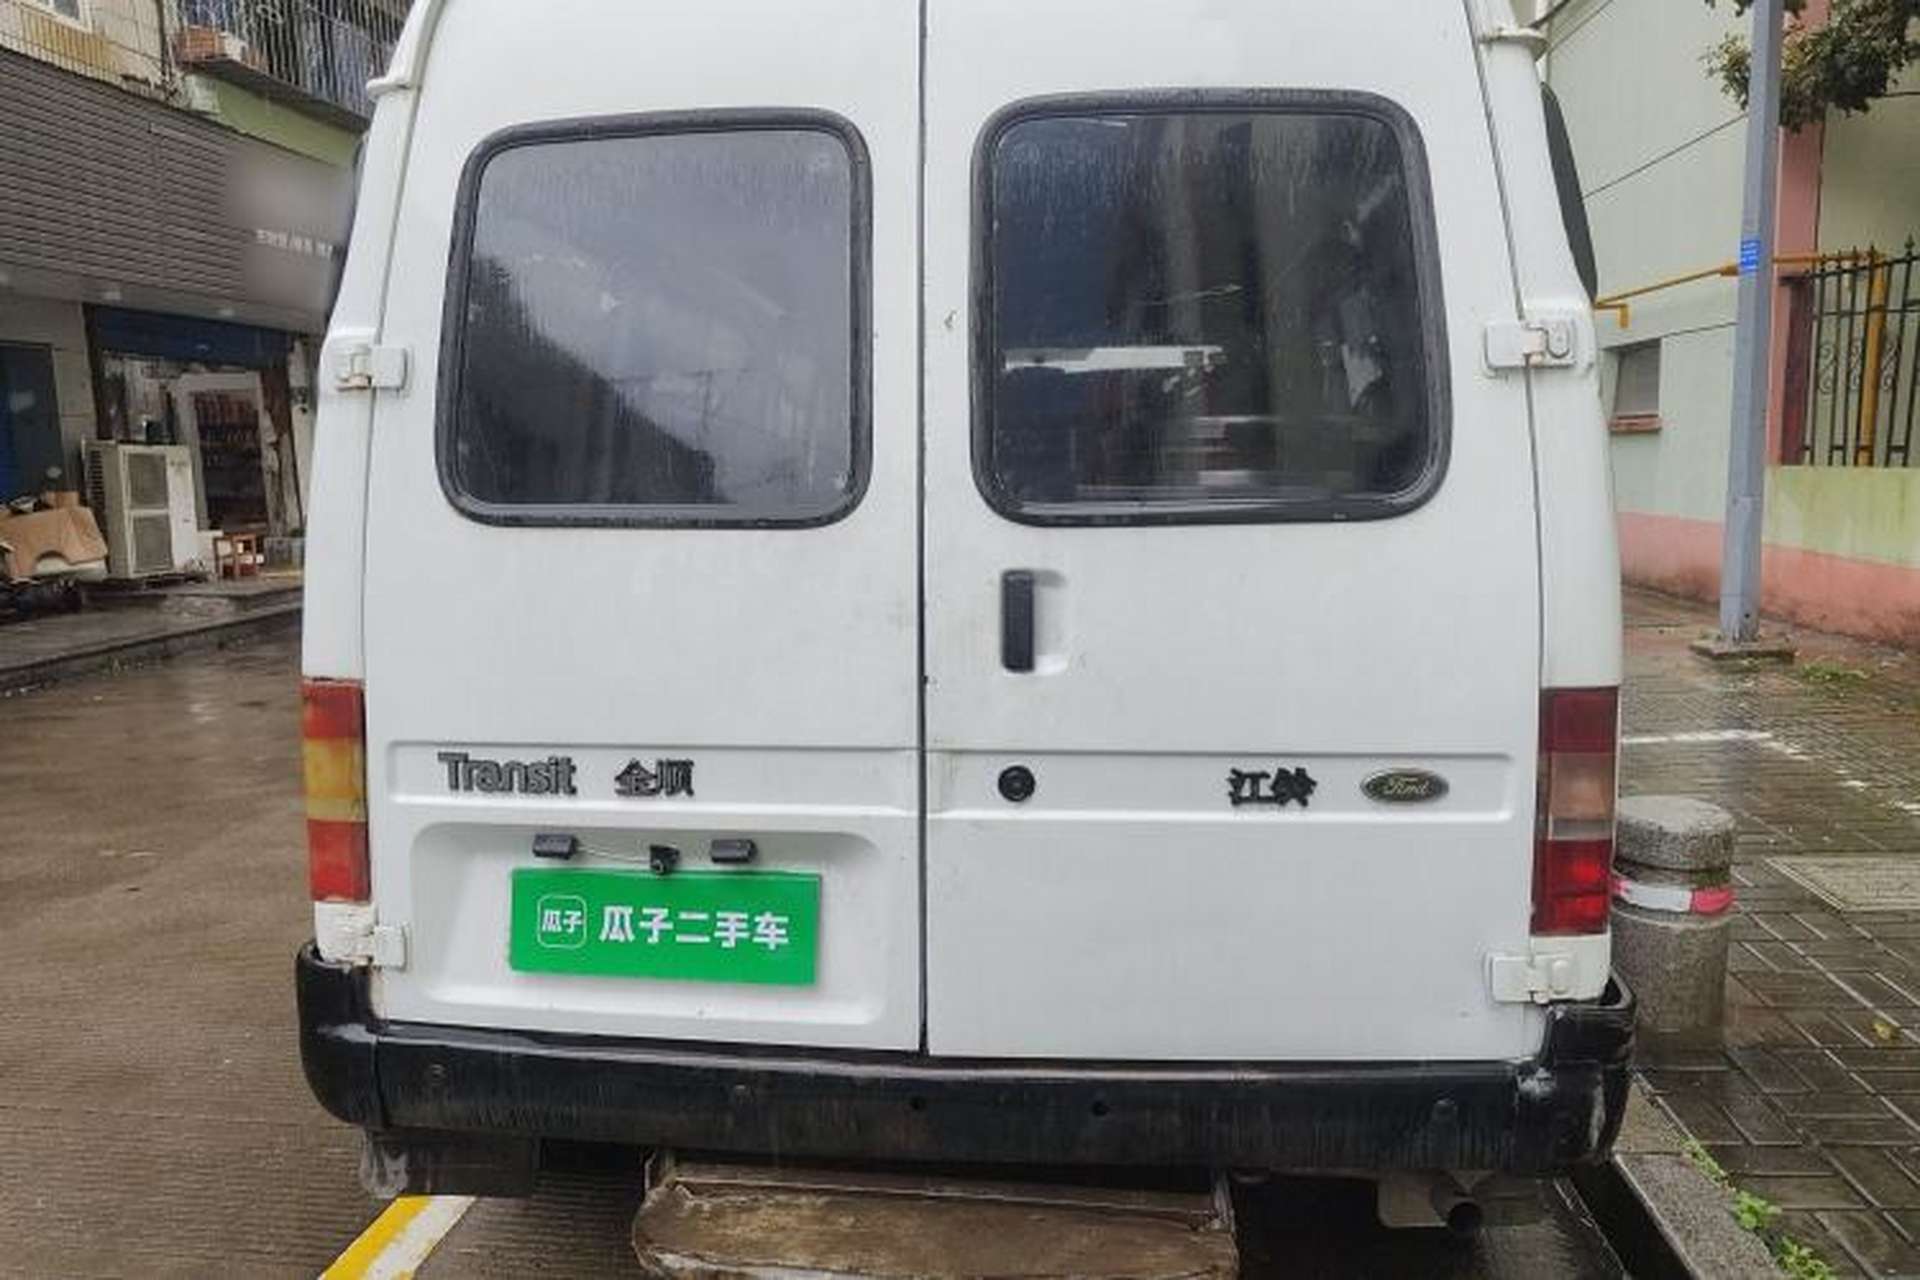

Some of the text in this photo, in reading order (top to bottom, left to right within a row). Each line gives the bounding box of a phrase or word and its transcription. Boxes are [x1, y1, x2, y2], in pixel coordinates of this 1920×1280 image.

[437, 752, 577, 796] Transit
[541, 909, 584, 933] 瓜子
[599, 905, 790, 950] 瓜子二手车
